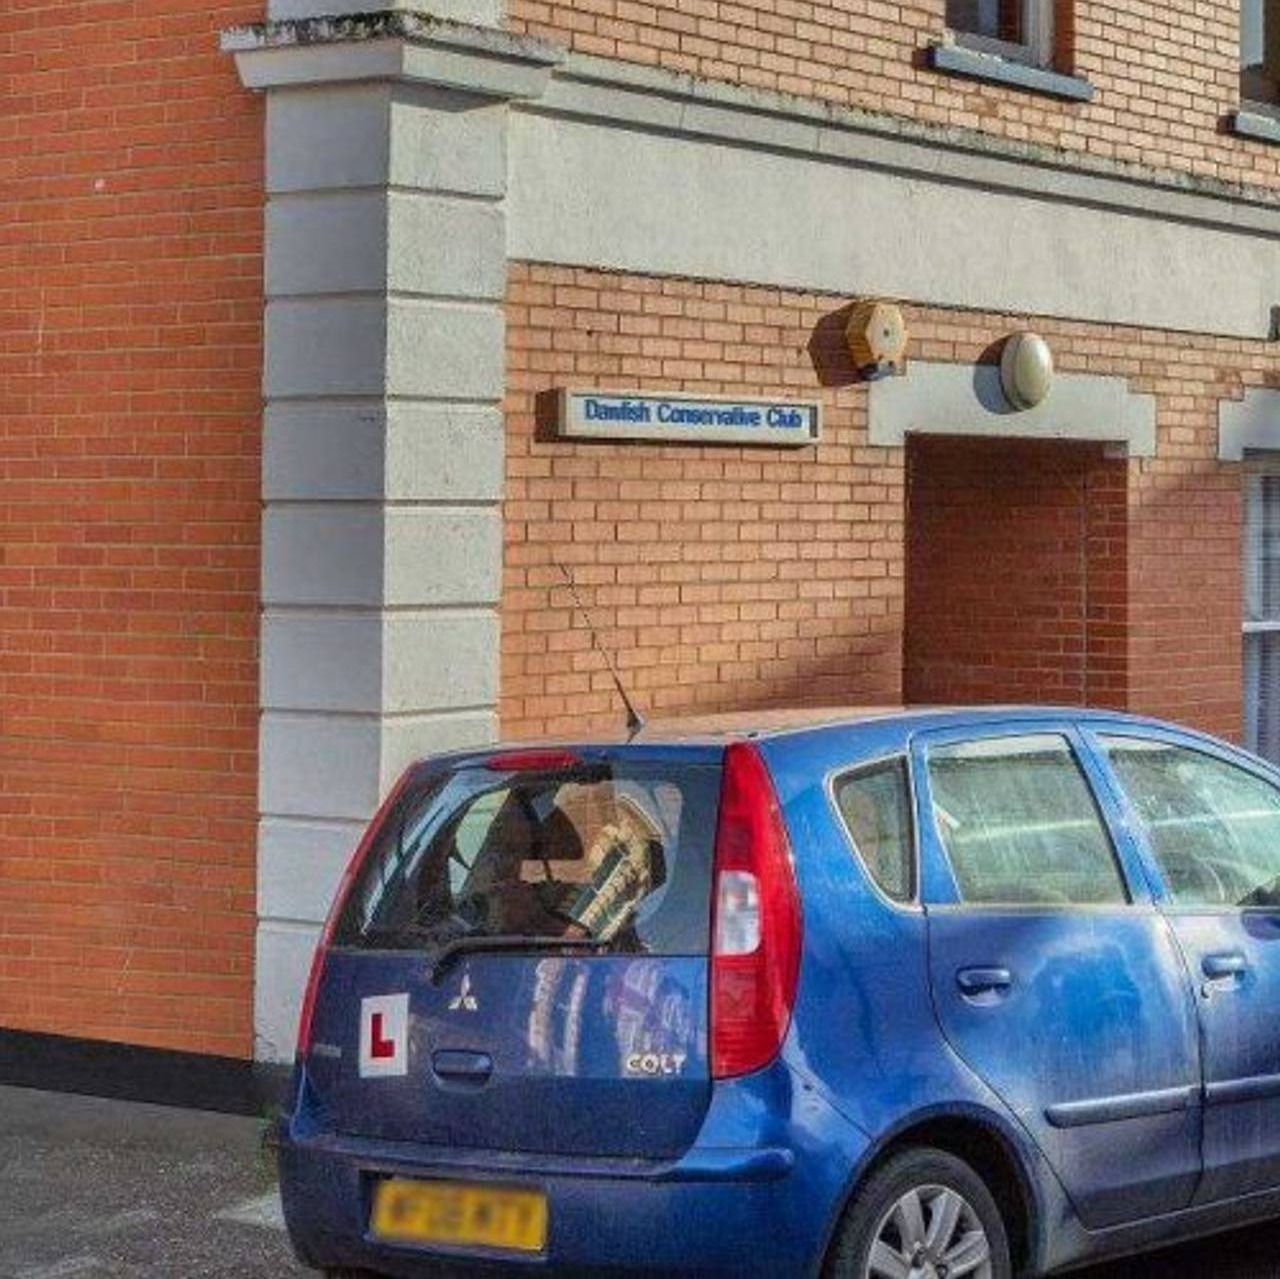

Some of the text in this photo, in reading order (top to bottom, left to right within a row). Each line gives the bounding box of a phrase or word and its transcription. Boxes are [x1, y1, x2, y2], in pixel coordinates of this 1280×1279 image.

[657, 404, 761, 426] Conservative
[766, 408, 802, 428] Club
[371, 1013, 395, 1058] L
[626, 1053, 687, 1074] COLT
